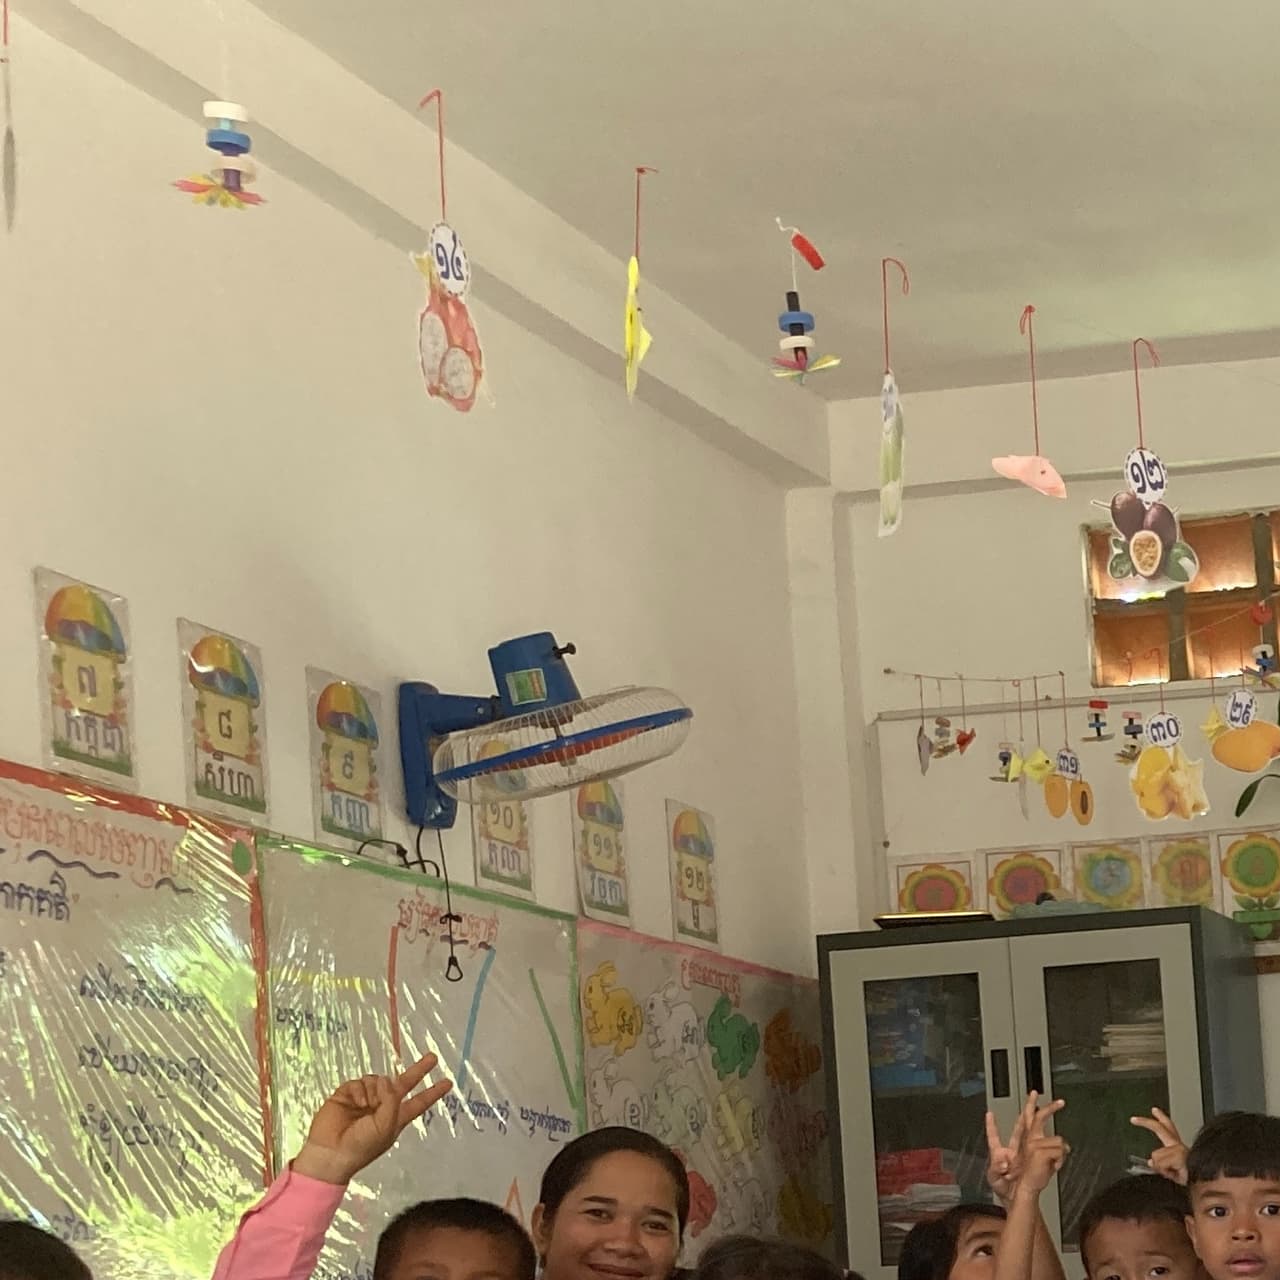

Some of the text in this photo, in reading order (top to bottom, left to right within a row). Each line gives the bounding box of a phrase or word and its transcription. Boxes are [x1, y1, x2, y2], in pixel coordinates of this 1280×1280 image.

[1131, 454, 1166, 497] ១២
[78, 665, 97, 698] ៧
[217, 710, 234, 740] ៨
[1149, 717, 1179, 742] ៣០
[204, 750, 255, 796] សីហា
[341, 752, 355, 778] ៩
[1059, 753, 1081, 775] ៣១
[489, 802, 513, 830] ១០
[486, 842, 522, 875] តុលា
[592, 836, 614, 860] ១១
[684, 867, 704, 891] ១២
